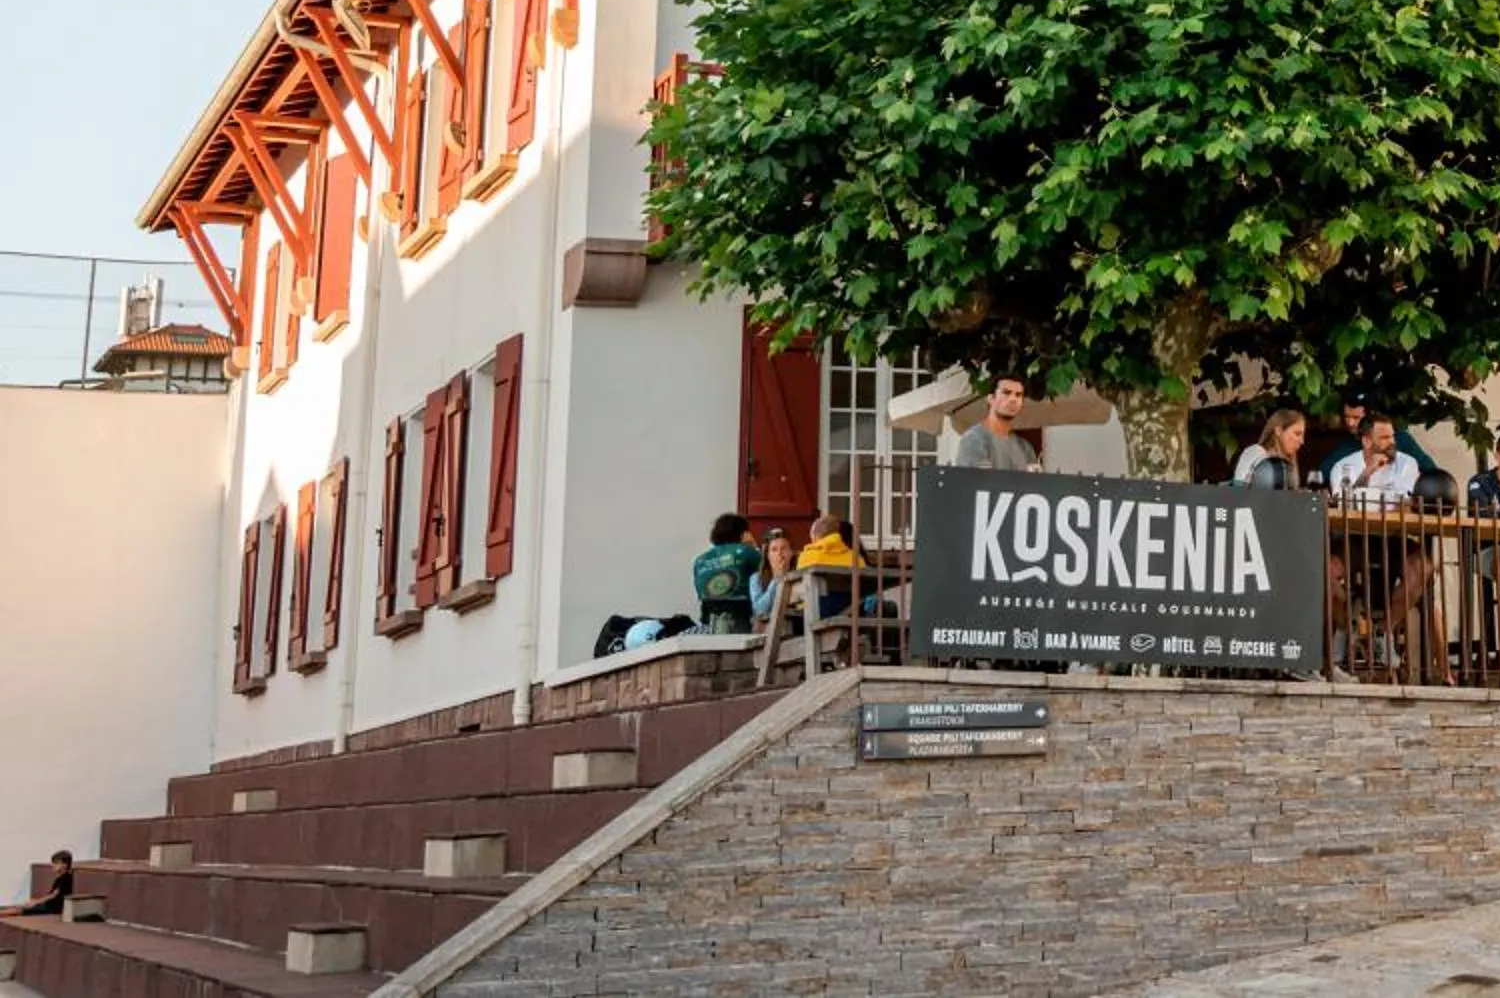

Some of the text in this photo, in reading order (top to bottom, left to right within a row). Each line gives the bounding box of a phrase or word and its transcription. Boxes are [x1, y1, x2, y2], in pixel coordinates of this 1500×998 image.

[979, 595, 1257, 619] AUBERGE MUSICALE GOURMANDE
[932, 627, 1006, 647] RESTAURANT
[1045, 632, 1069, 649] BAR
[1081, 633, 1121, 652] VIANDE
[1163, 634, 1197, 654] HÔTEL
[1229, 638, 1276, 658] ÉPICERIE
